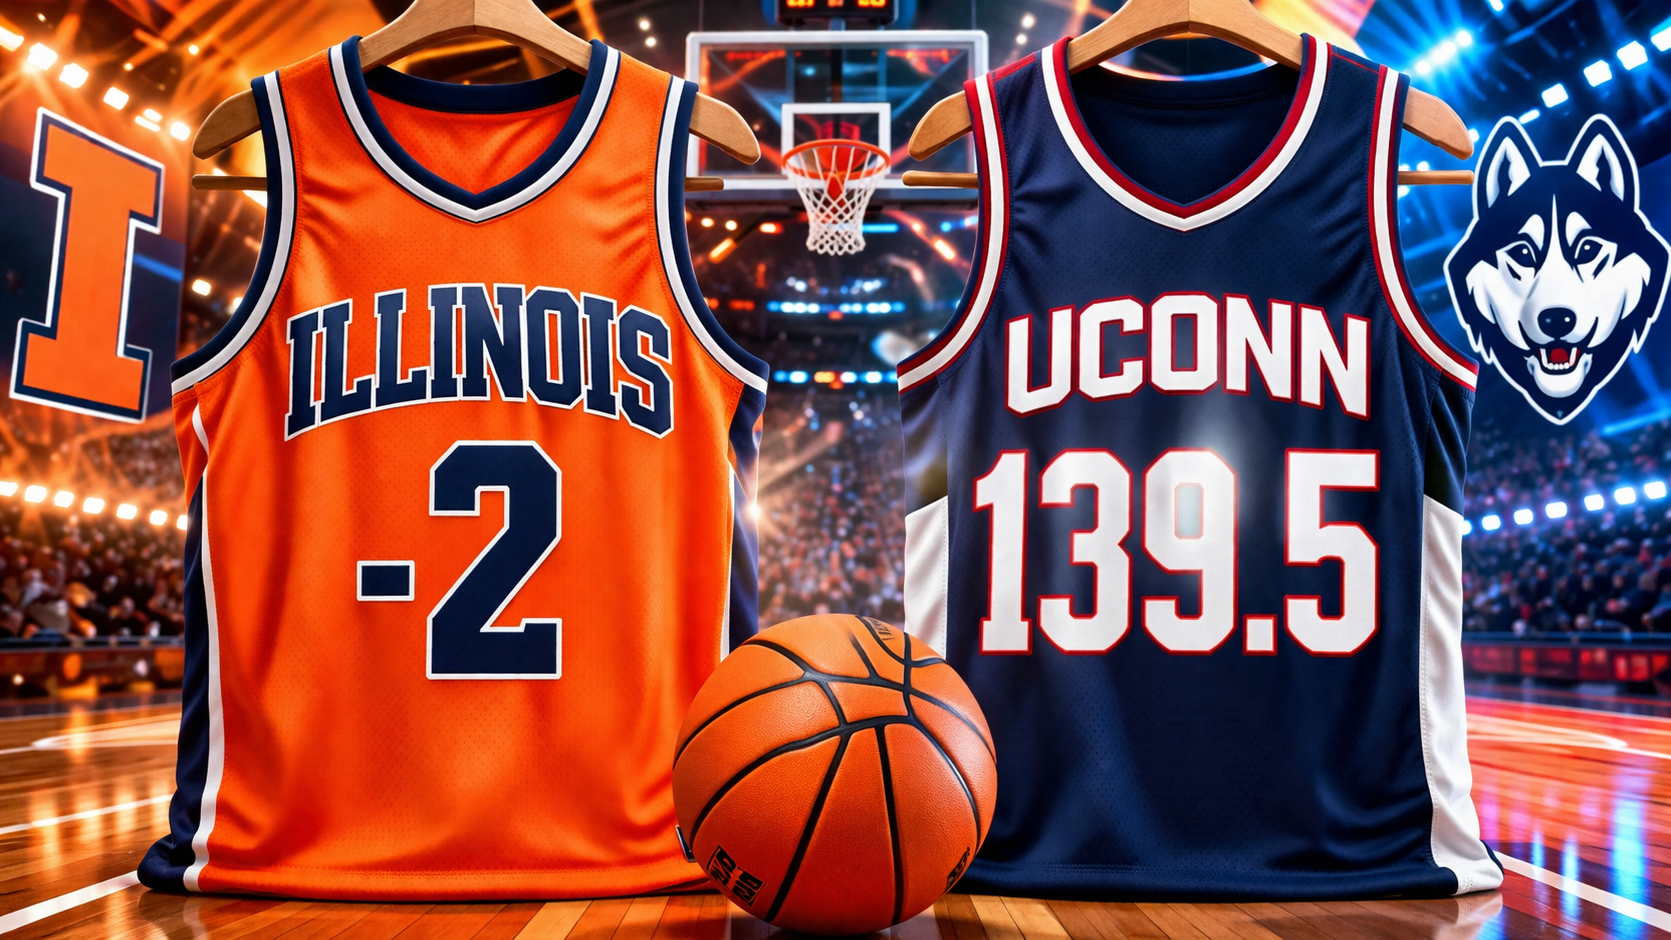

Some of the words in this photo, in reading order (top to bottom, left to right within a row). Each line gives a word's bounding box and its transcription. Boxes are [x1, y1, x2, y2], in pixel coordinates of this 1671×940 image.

[9, 106, 165, 424] I
[284, 283, 674, 441] ILLINOIS
[1005, 291, 1371, 421] UCONN
[357, 440, 562, 680] -2
[973, 447, 1380, 657] 139.5
